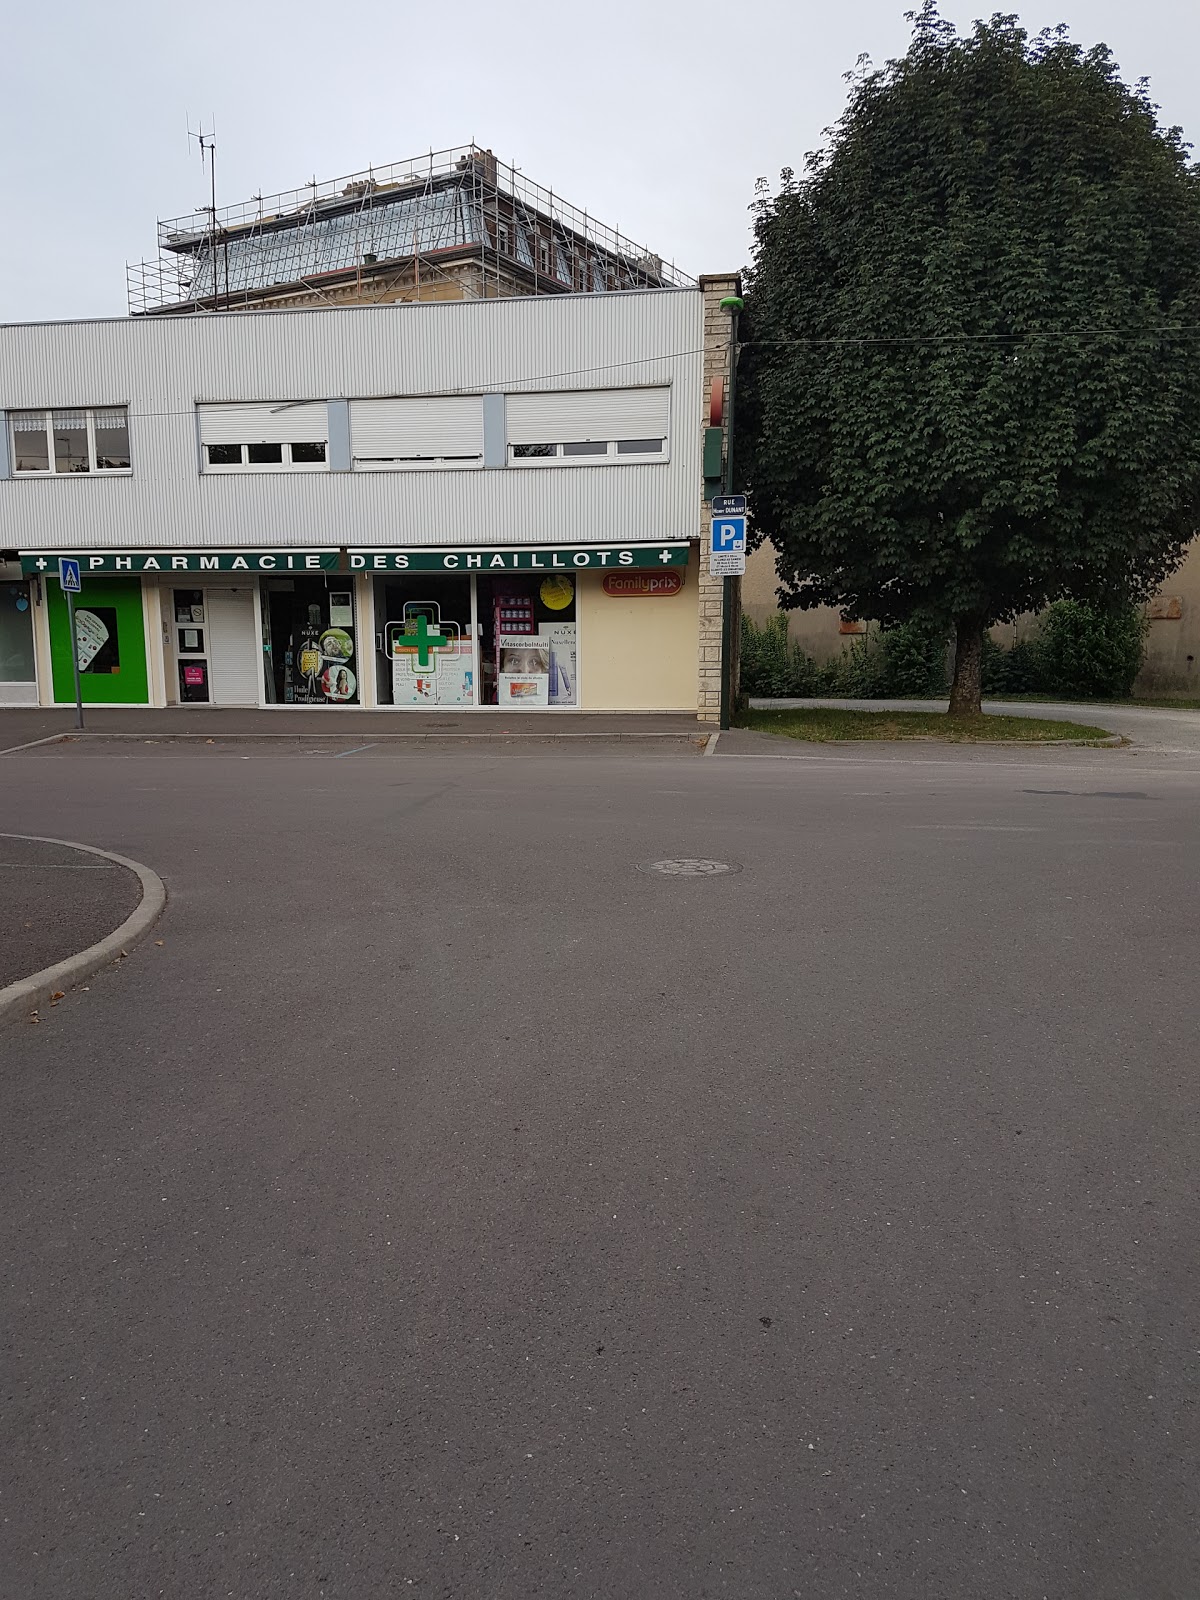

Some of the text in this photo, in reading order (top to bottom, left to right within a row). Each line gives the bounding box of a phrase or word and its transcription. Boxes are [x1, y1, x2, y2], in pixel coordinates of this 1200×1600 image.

[721, 525, 735, 546] P
[89, 551, 634, 570] PHARMACIE DES CHAILLOTS
[608, 576, 676, 591] Familyprix
